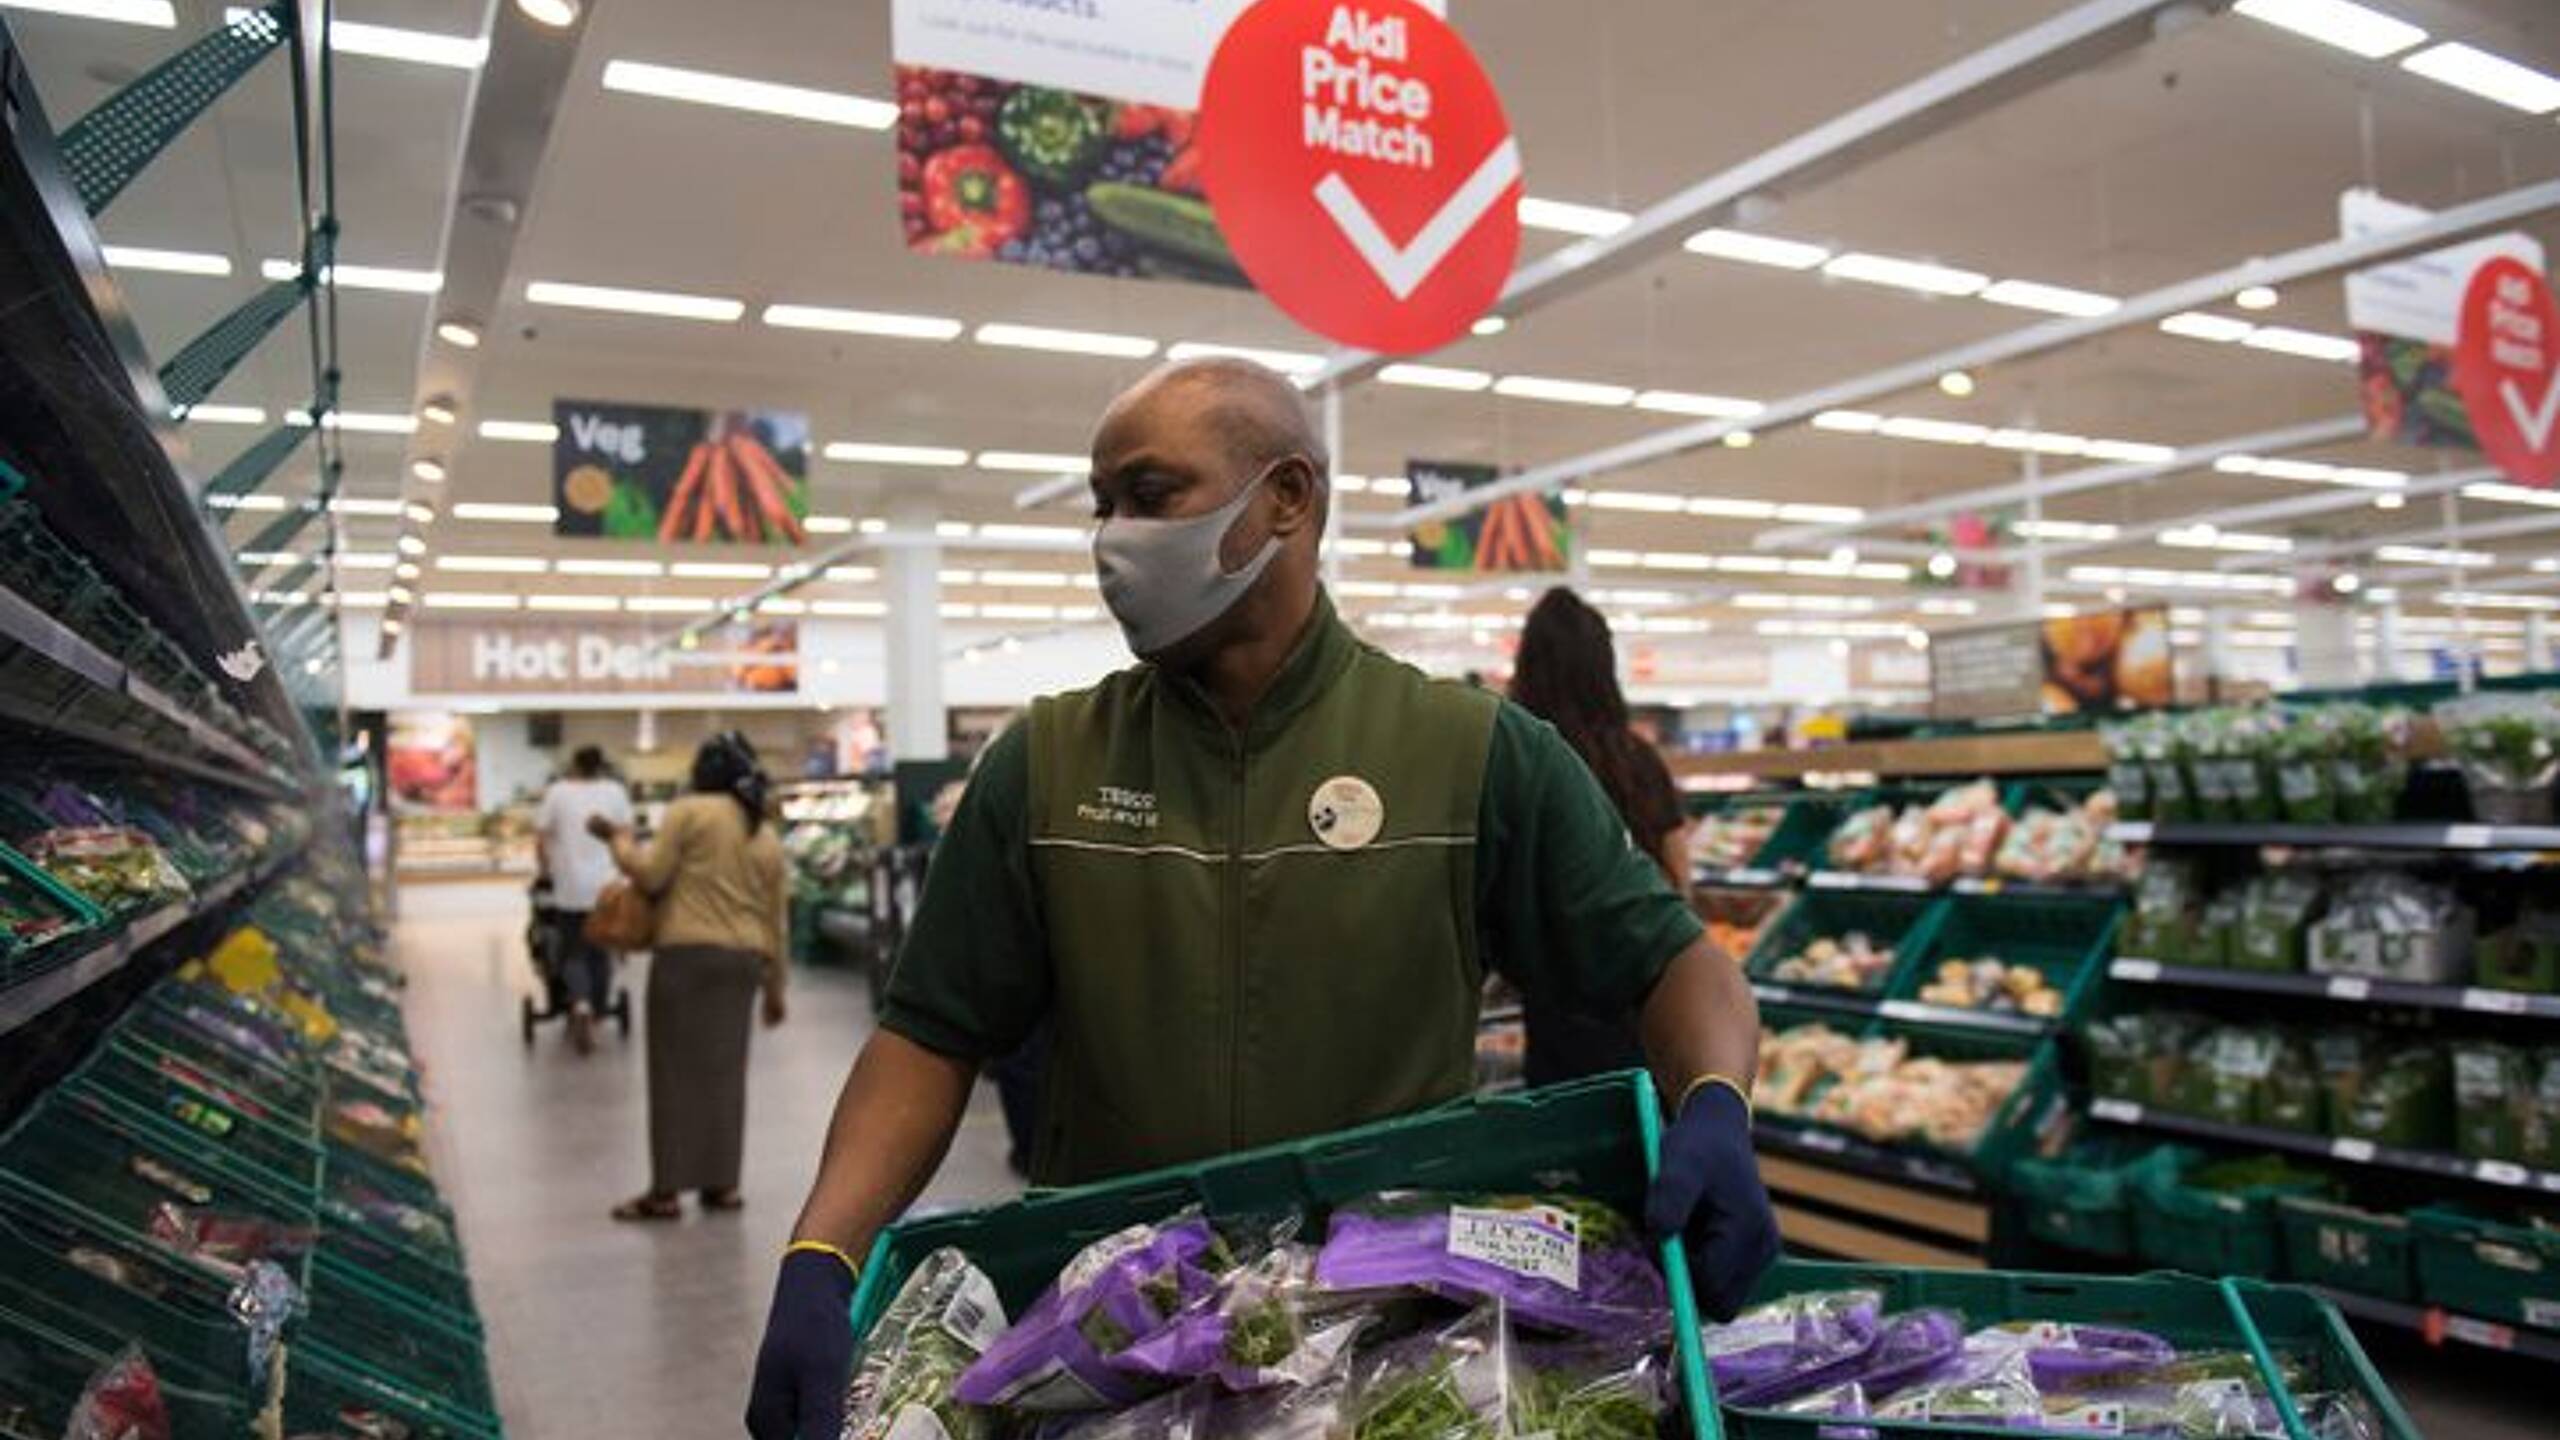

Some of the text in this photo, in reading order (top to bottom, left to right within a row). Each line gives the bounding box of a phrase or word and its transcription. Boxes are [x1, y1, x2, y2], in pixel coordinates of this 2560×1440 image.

[1326, 5, 1407, 62] Aldi
[1302, 46, 1431, 120] Price
[1303, 102, 1434, 170] Match
[569, 412, 645, 464] Veg
[472, 633, 569, 681] Hot
